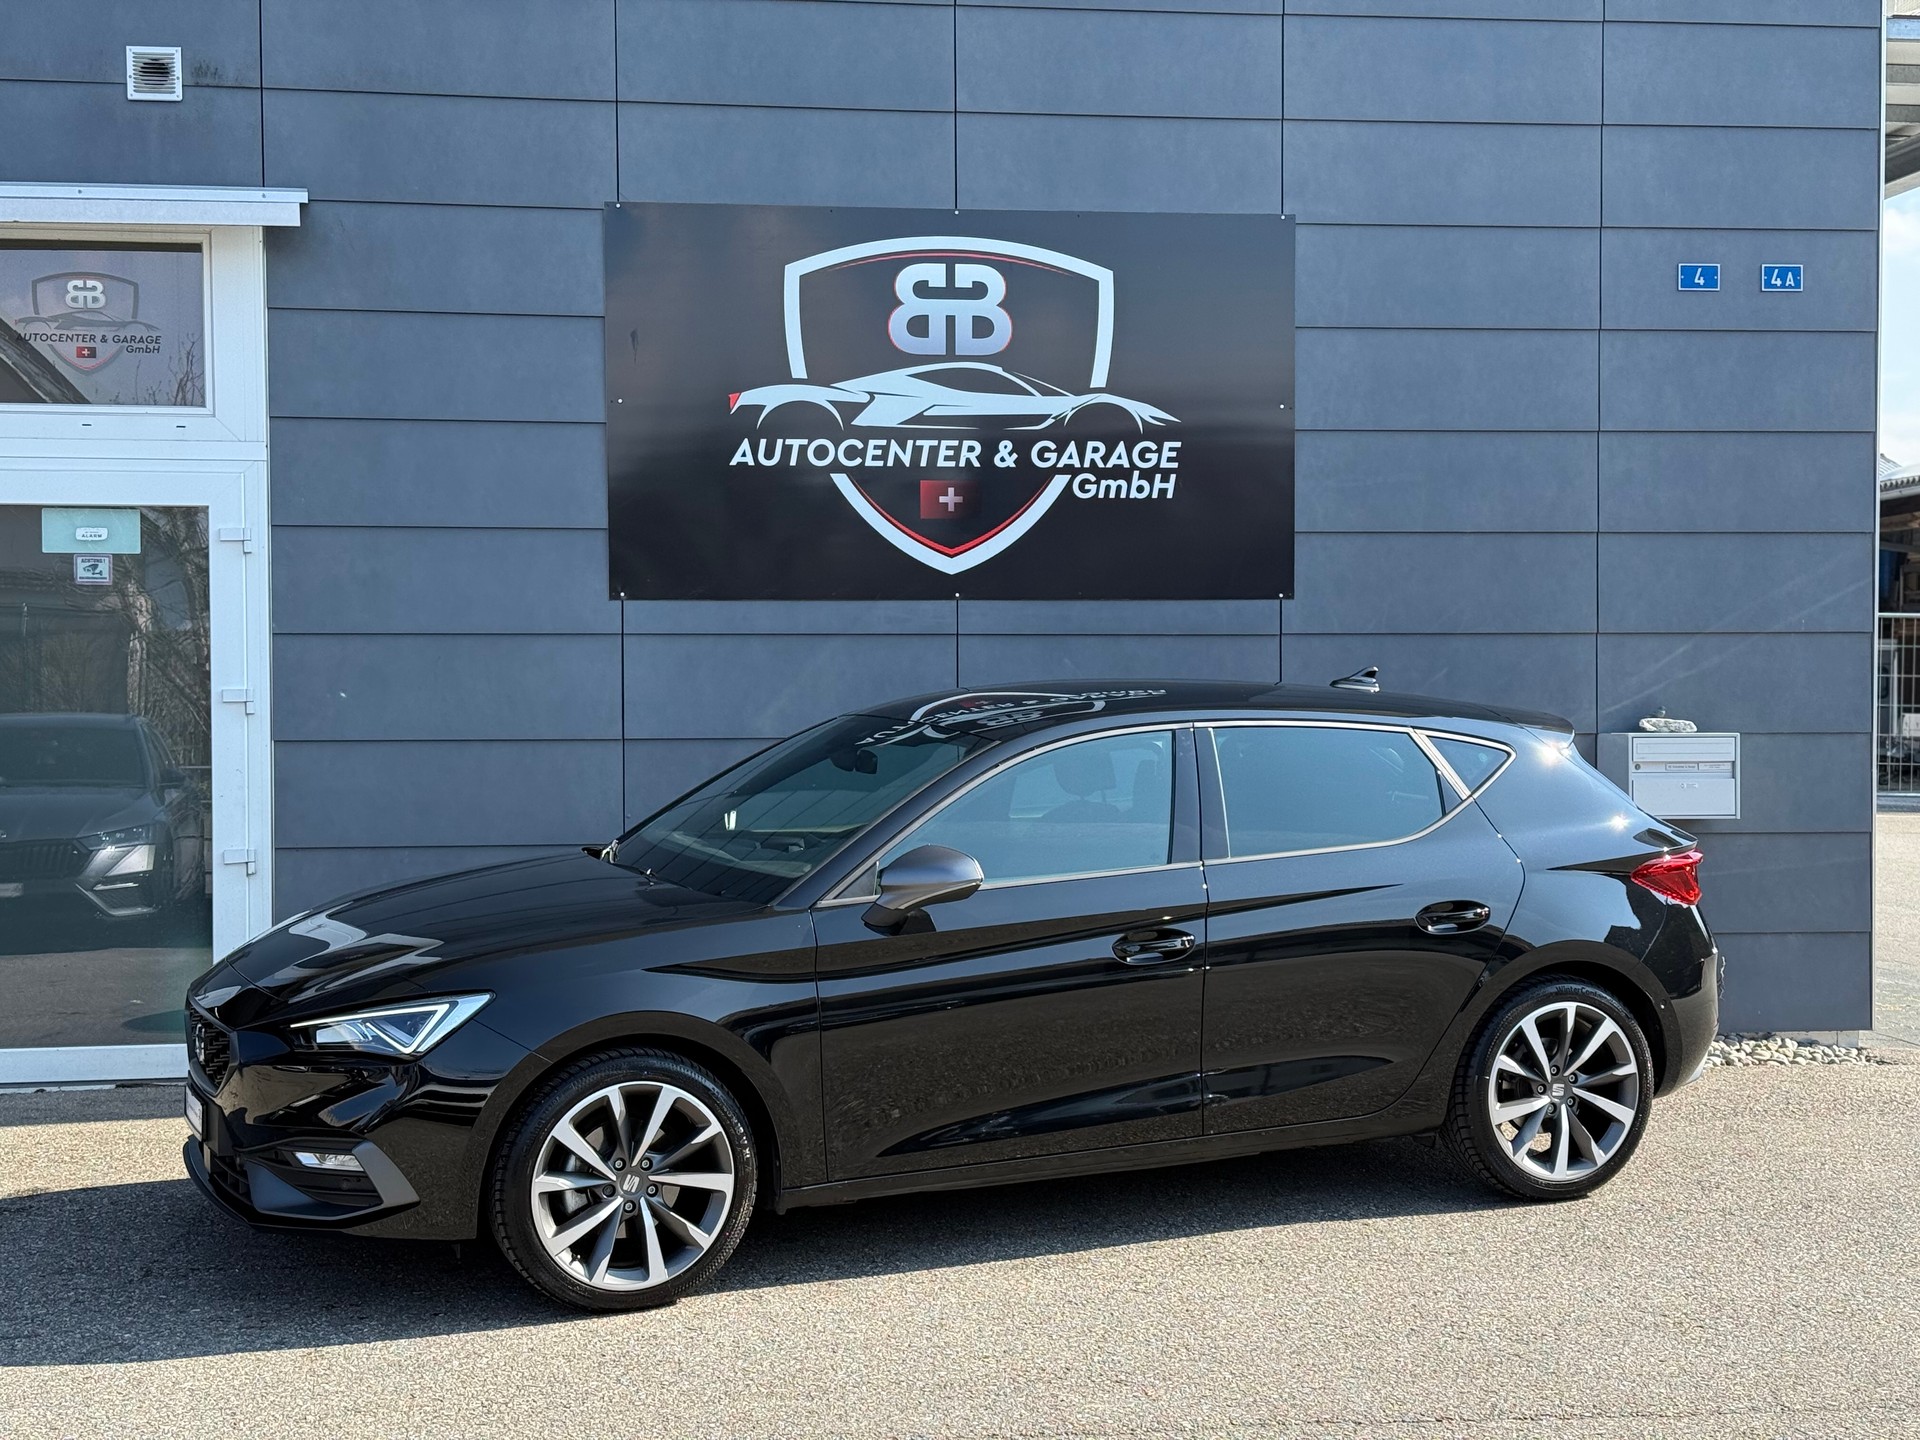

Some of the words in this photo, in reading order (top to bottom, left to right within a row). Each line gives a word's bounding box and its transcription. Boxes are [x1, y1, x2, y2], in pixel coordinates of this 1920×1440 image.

[1694, 267, 1705, 286] 4
[15, 332, 97, 344] AUTOCENTER
[100, 334, 108, 344] &
[112, 334, 162, 345] GARAGE
[126, 345, 161, 354] GmbH
[729, 437, 982, 468] AUTOCENTER
[993, 439, 1019, 468] &
[1030, 440, 1182, 469] GARAGE
[1072, 471, 1177, 499] GmbH
